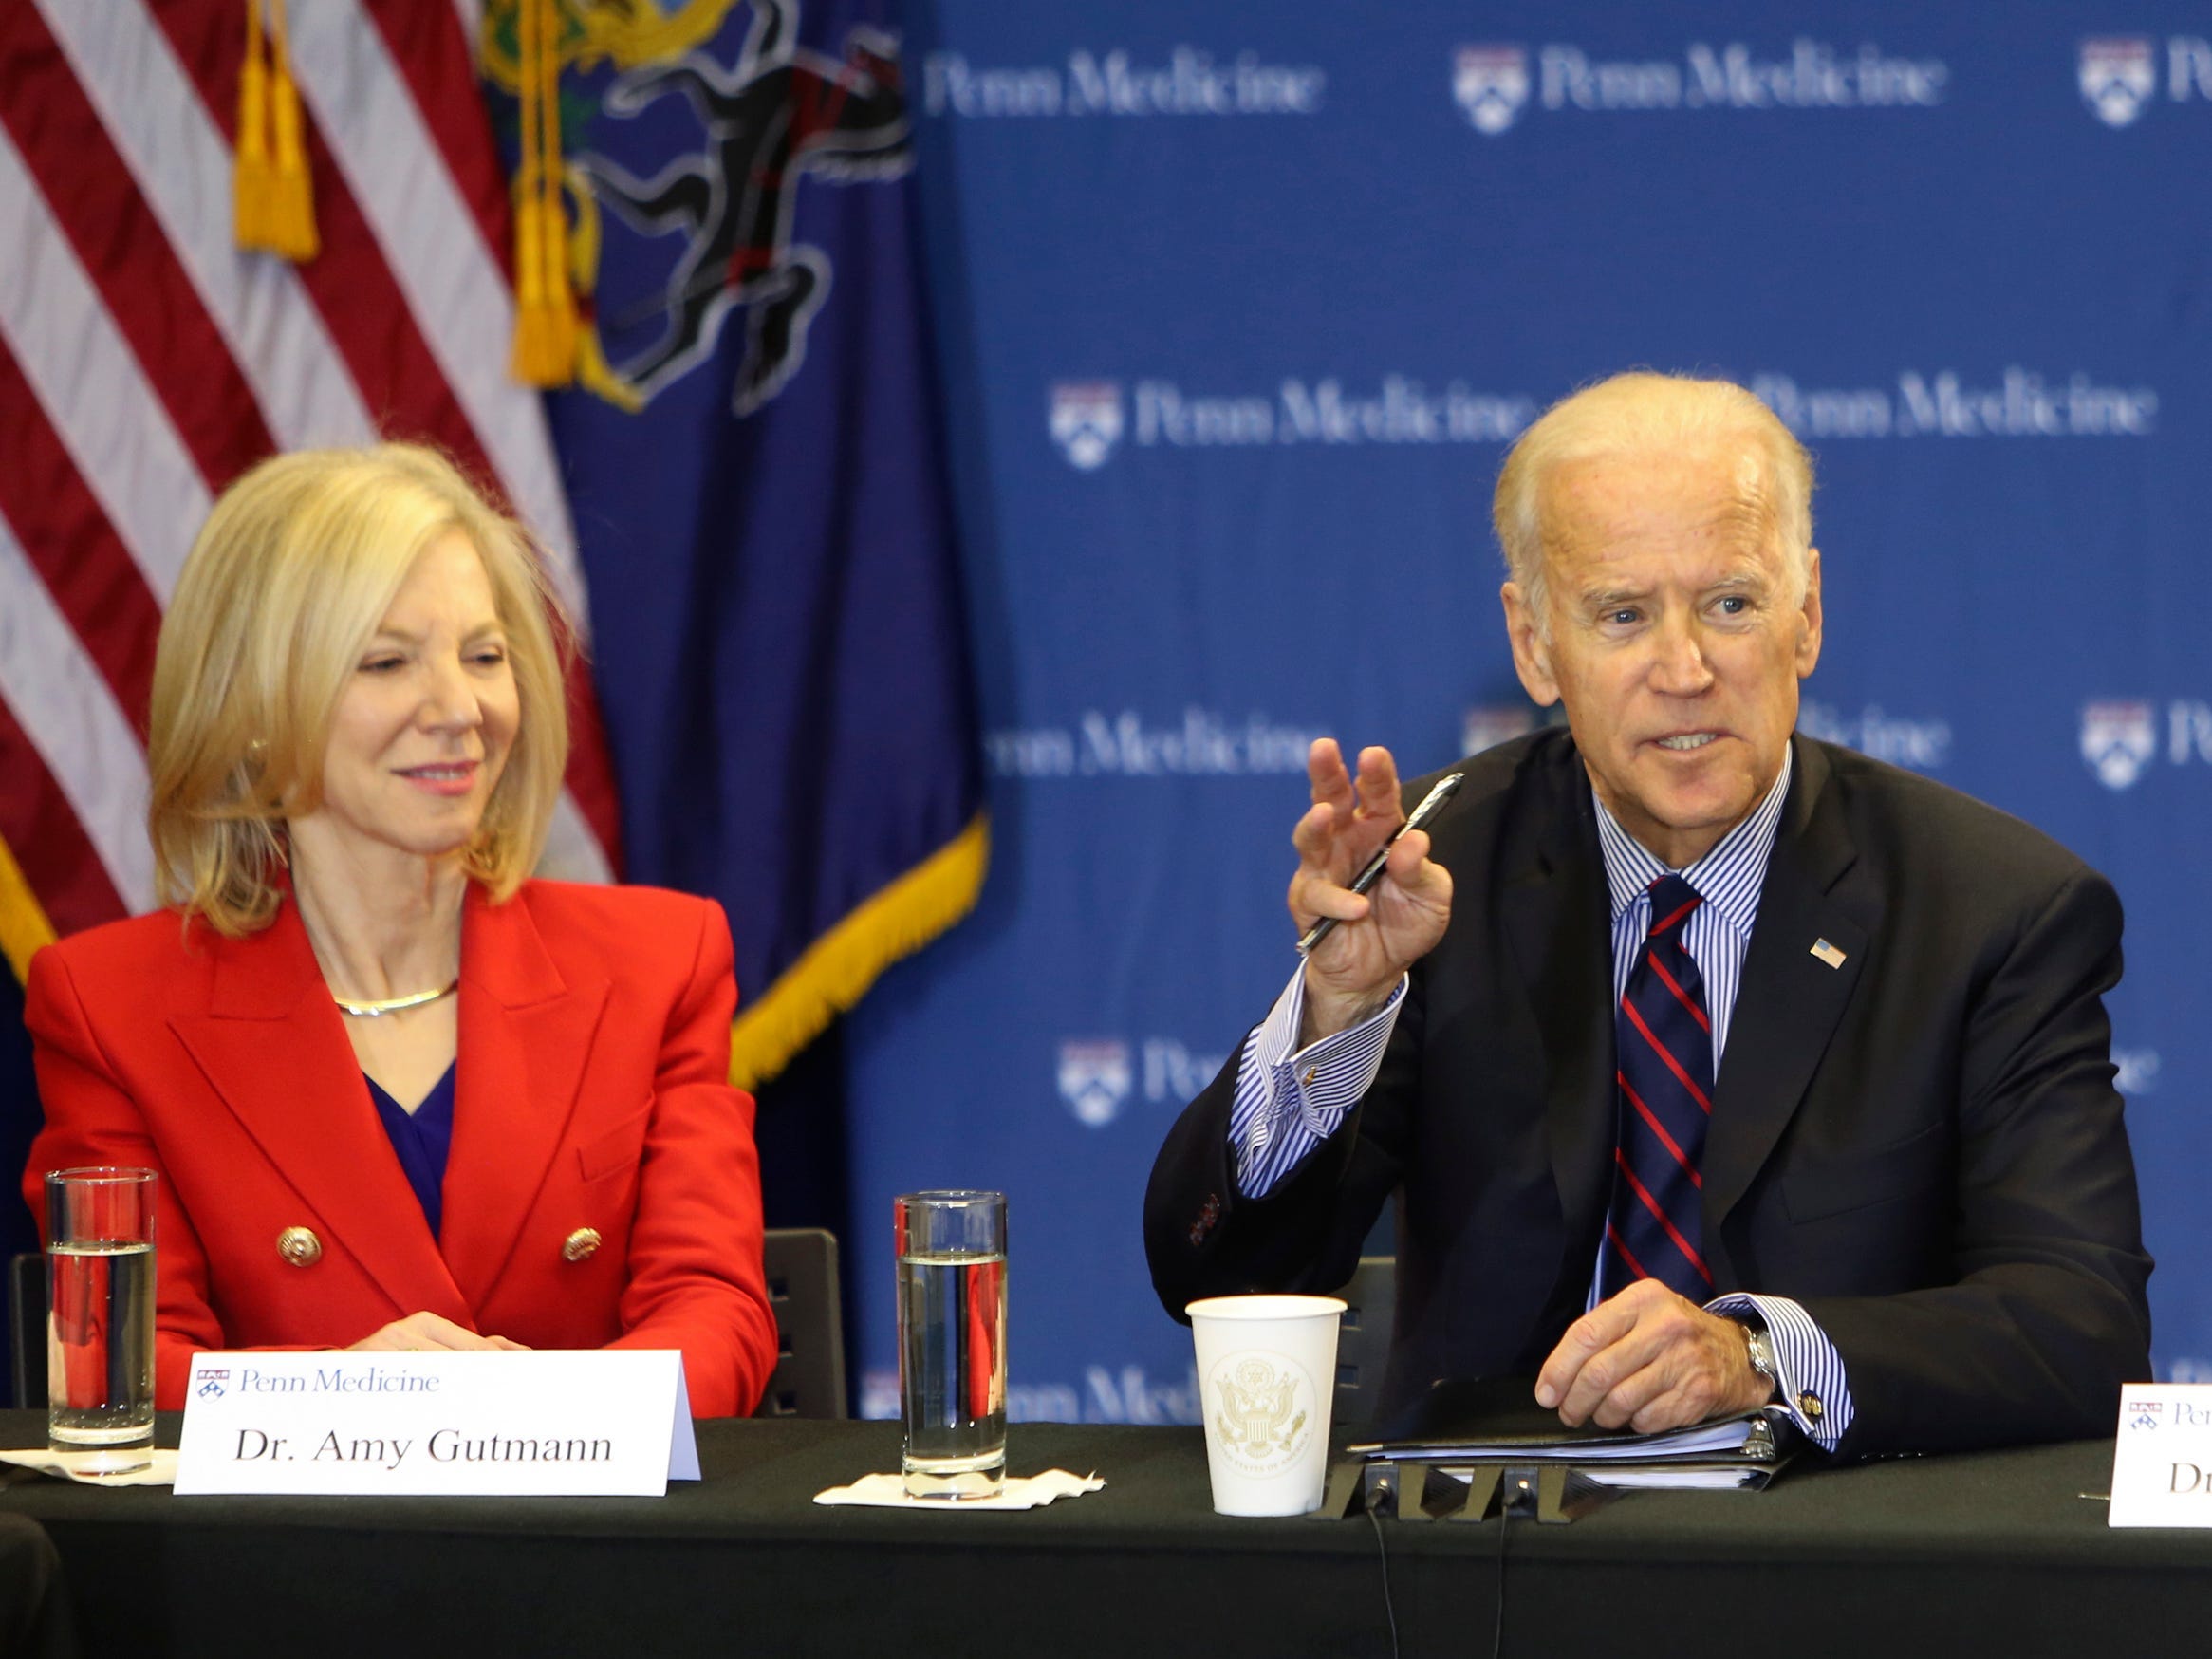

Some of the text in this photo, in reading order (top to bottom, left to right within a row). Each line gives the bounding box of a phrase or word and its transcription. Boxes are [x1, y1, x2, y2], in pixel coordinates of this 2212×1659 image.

[925, 46, 1324, 116] Penn Medicine
[1542, 39, 1947, 108] Penn Medicine
[1139, 382, 1273, 445] Penn
[1900, 367, 2158, 436] Medicine
[239, 1367, 440, 1392] Penn Medicine
[2173, 1402, 2212, 1425] Pe
[232, 1428, 614, 1471] Dr. Amy Gutmann
